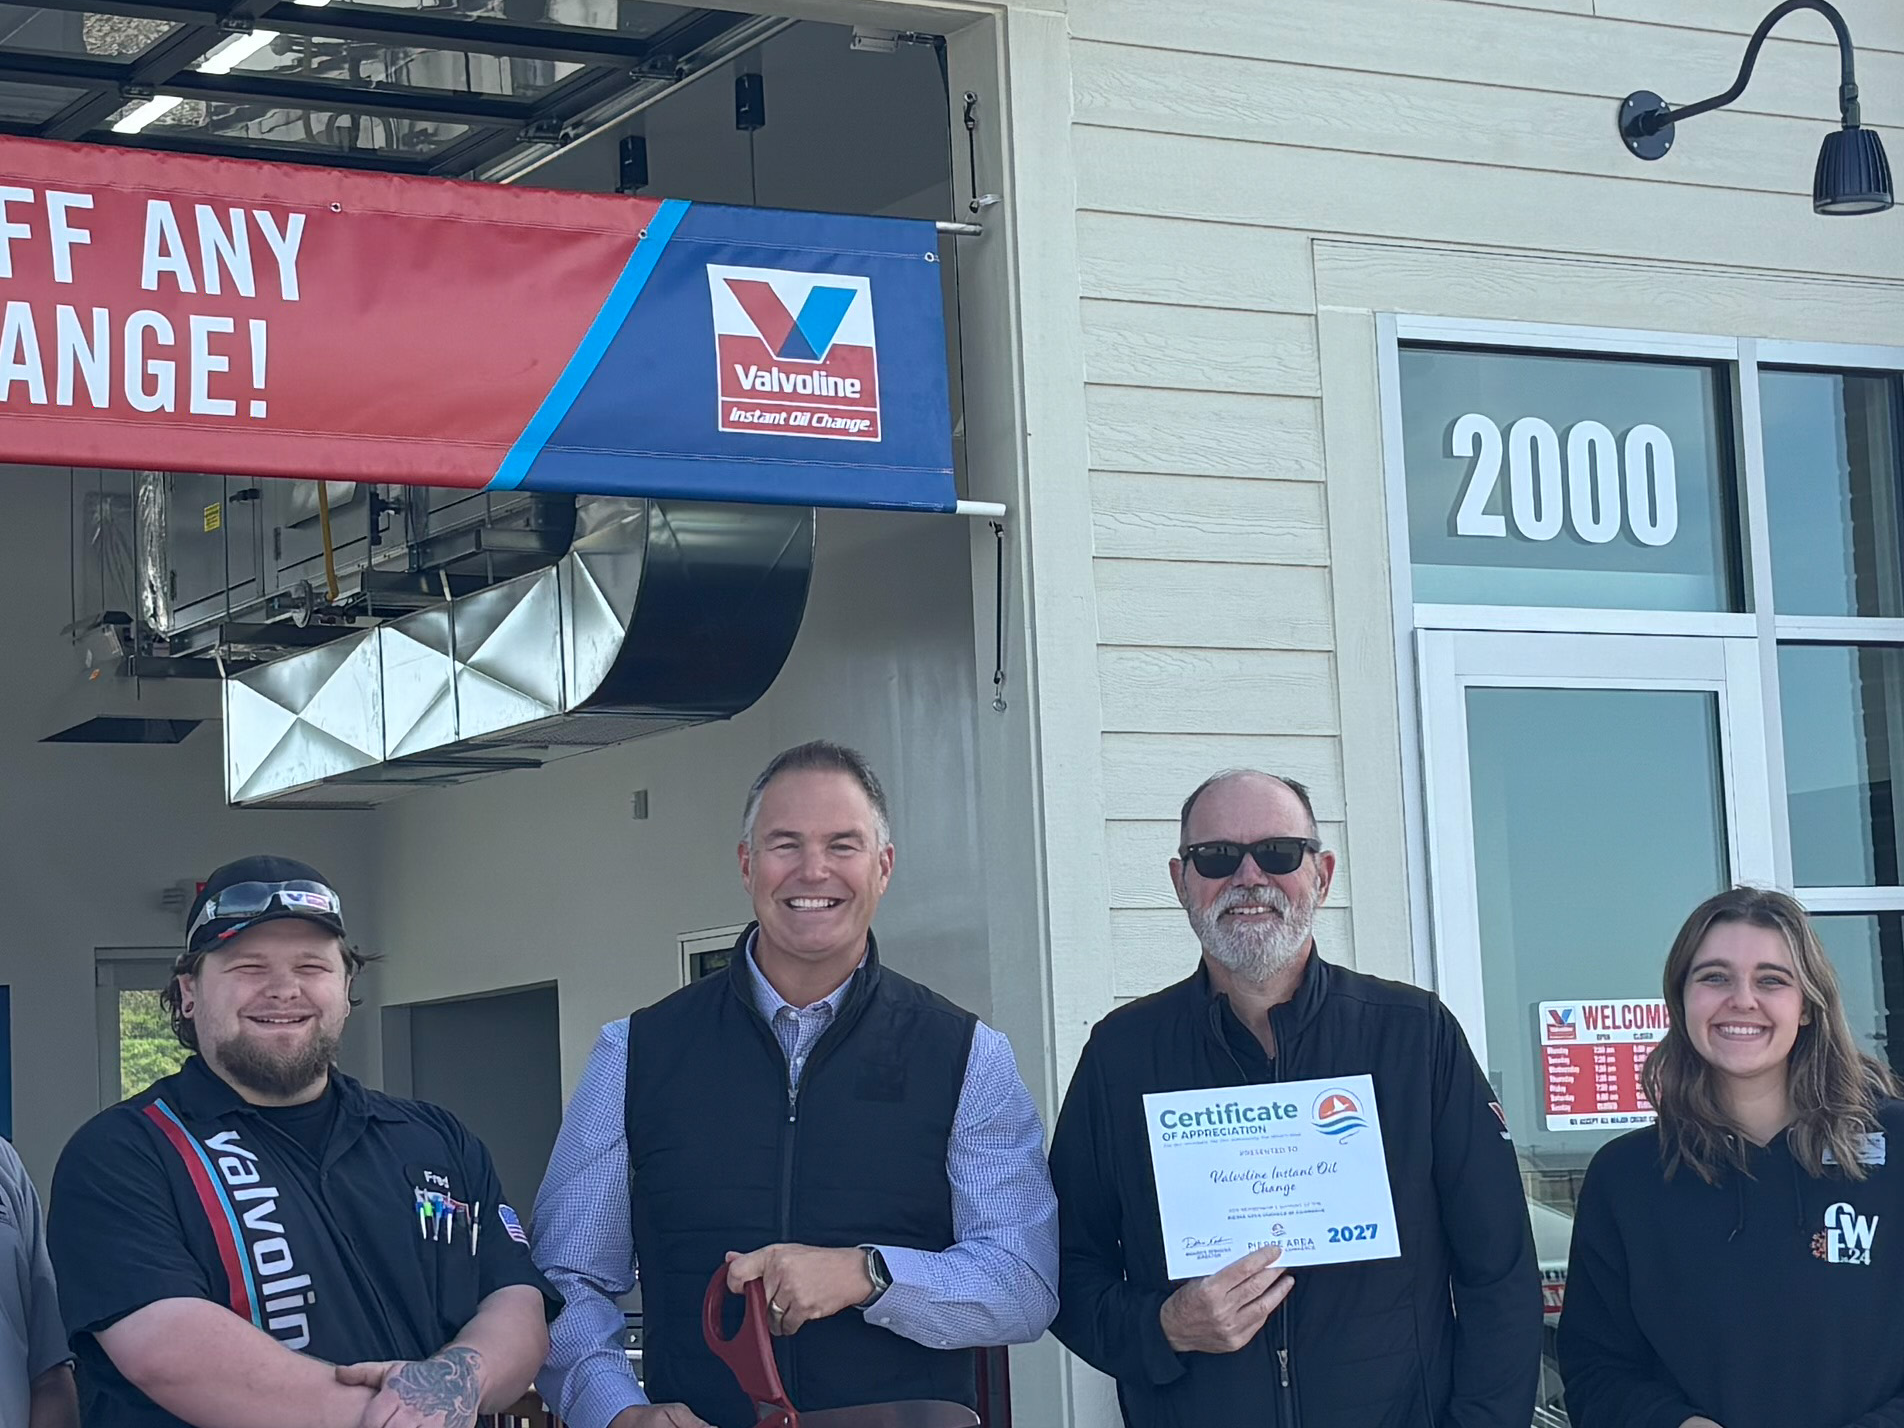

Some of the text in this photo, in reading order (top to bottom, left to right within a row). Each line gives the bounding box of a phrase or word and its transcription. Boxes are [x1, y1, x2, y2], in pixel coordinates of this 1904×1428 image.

[141, 200, 306, 301] ANY
[734, 363, 860, 398] Valvoline
[729, 407, 871, 432] Instant Oil Change
[1451, 413, 1678, 547] 2000
[1159, 1101, 1298, 1130] Certificate
[1162, 1132, 1178, 1142] OF
[1181, 1125, 1267, 1140] APPRECIATION
[1252, 1180, 1297, 1197] Change
[204, 1130, 316, 1350] Valvolin
[1327, 1223, 1378, 1244] 2027
